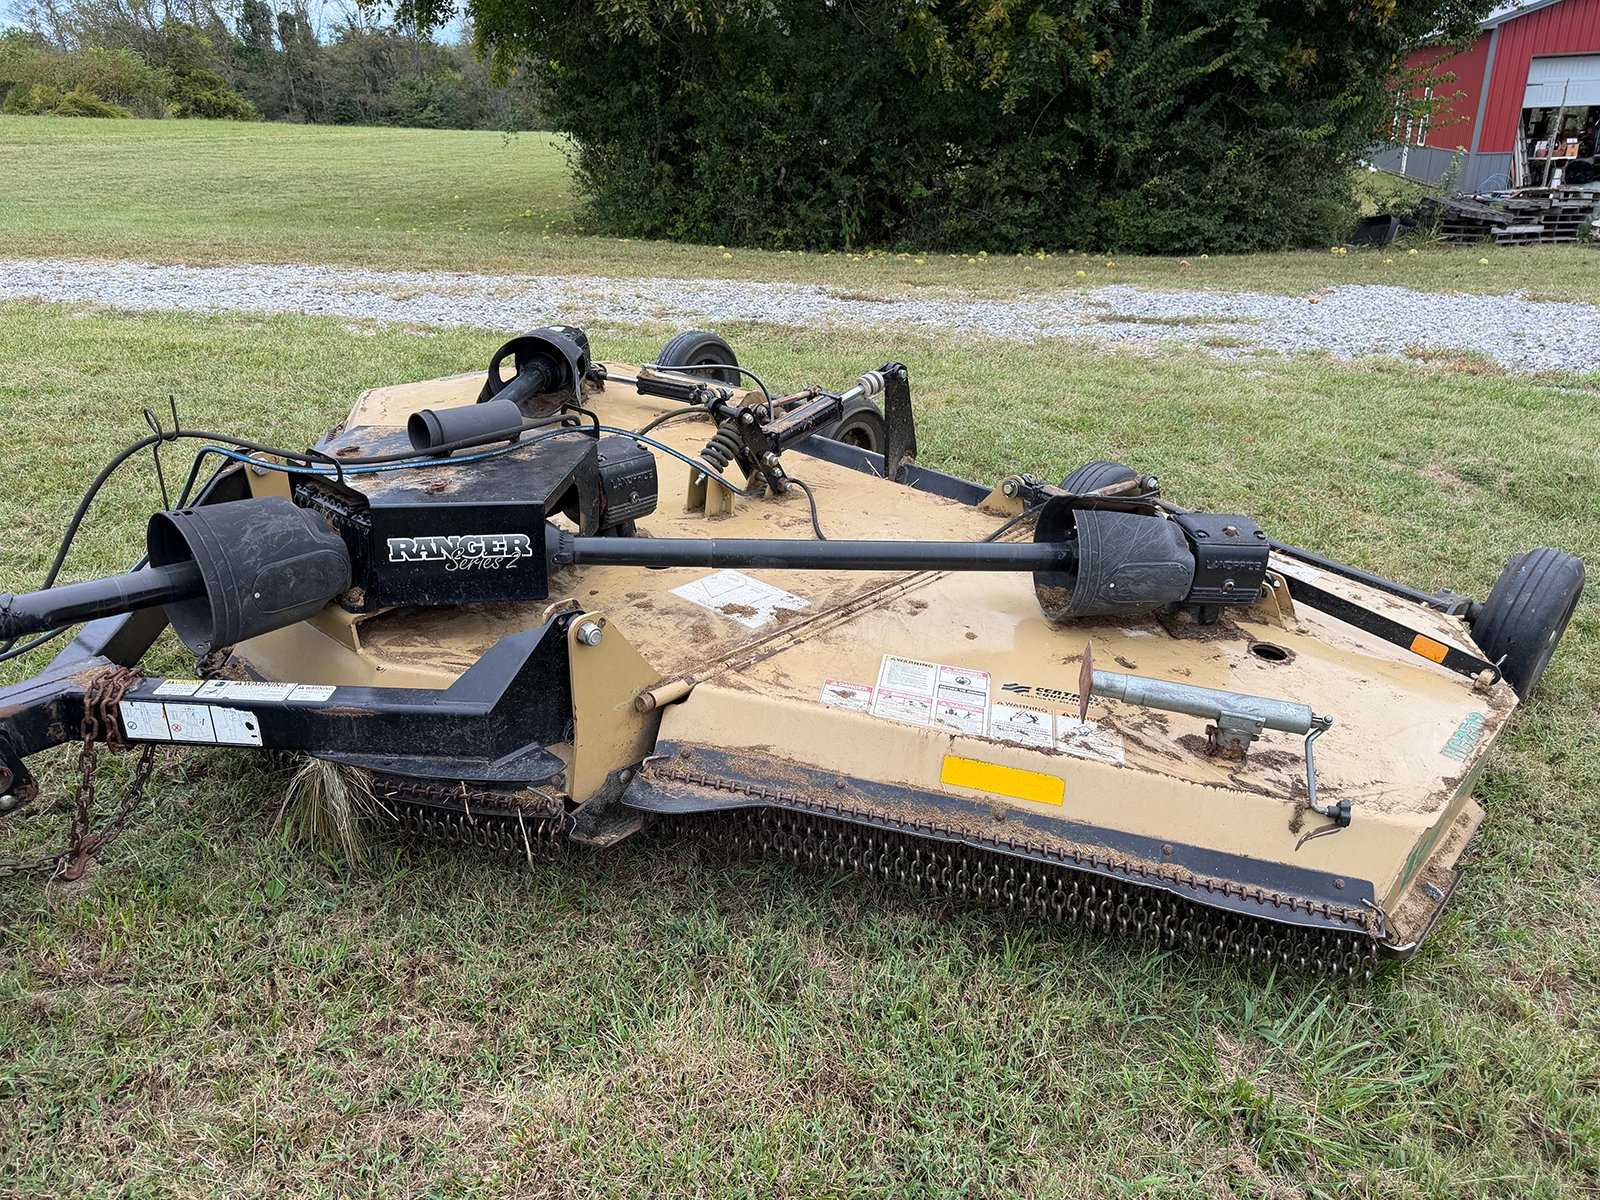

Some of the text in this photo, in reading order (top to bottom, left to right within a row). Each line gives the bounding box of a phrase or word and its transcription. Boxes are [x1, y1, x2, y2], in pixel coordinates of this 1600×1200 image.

[387, 534, 533, 562] RANGER
[445, 547, 522, 572] Series 2
[1204, 559, 1262, 571] LANDPRIDE
[894, 657, 934, 669] WARNING
[242, 680, 288, 688] WARNING
[1005, 701, 1048, 713] WARNING
